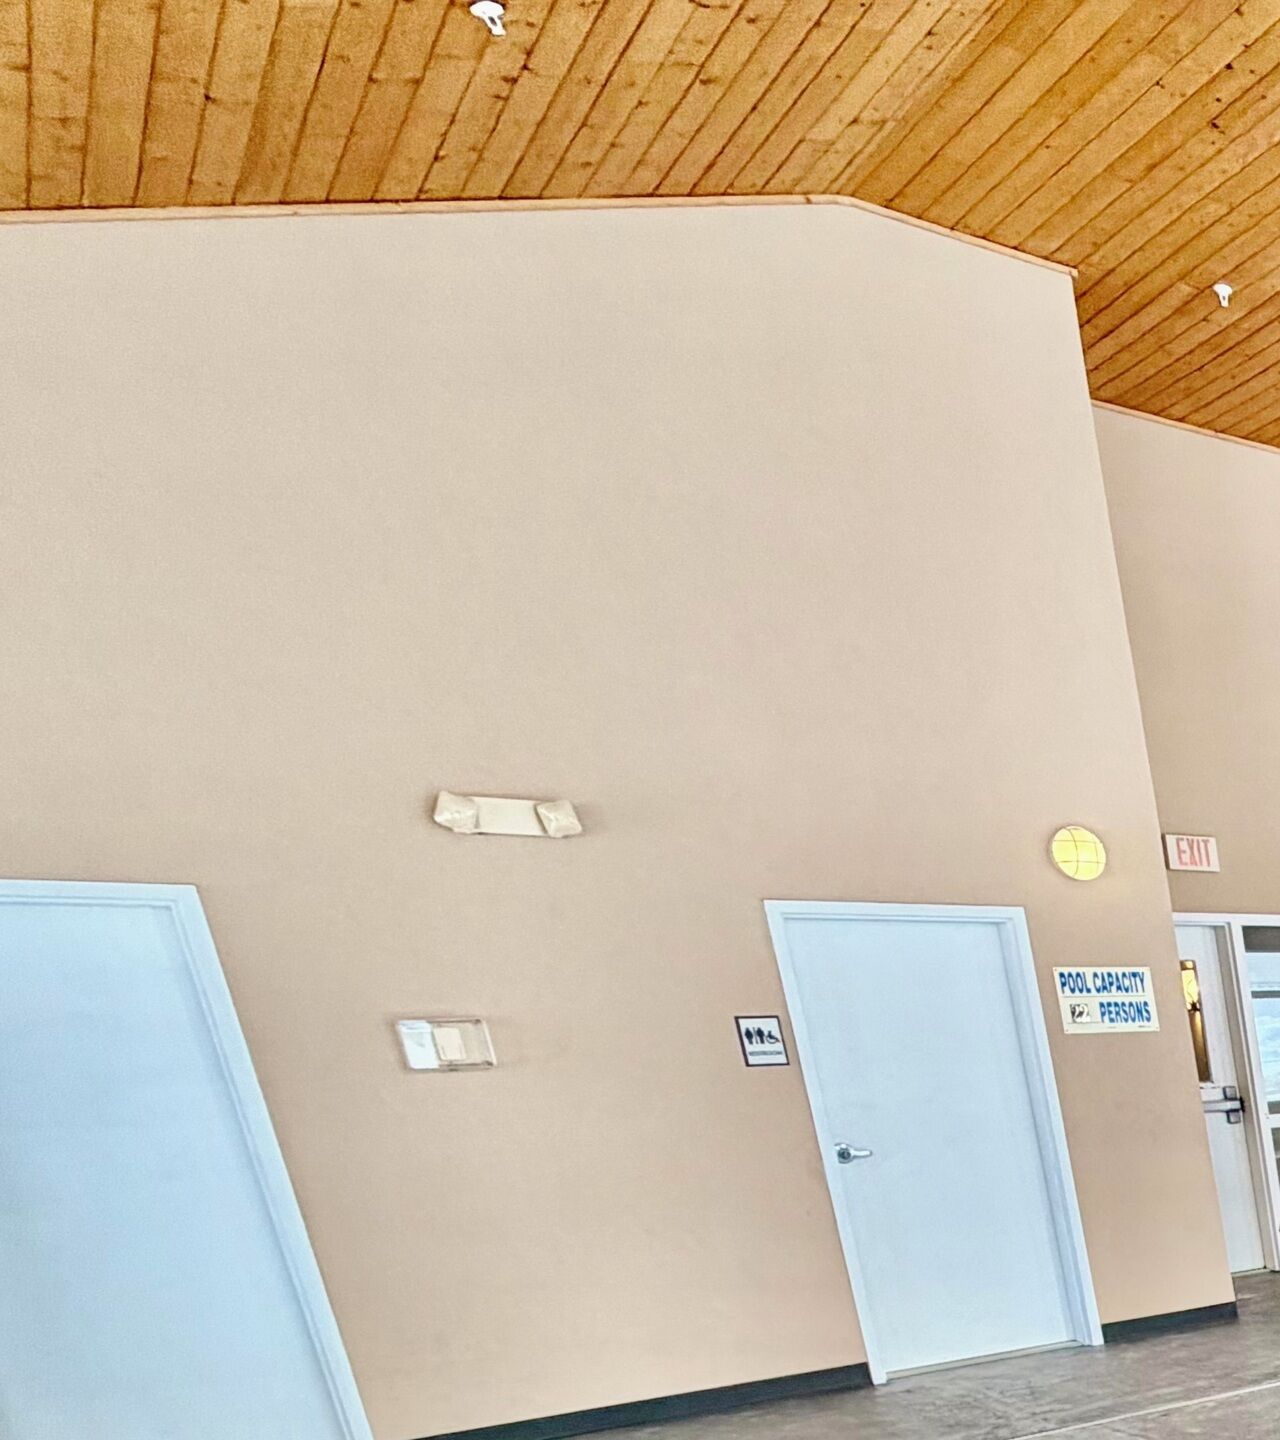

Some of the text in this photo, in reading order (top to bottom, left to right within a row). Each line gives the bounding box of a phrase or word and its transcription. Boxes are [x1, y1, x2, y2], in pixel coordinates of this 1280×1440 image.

[1175, 837, 1211, 868] EXIT
[1058, 971, 1145, 994] POOL CAPACITY
[1099, 1001, 1151, 1023] PERSONS
